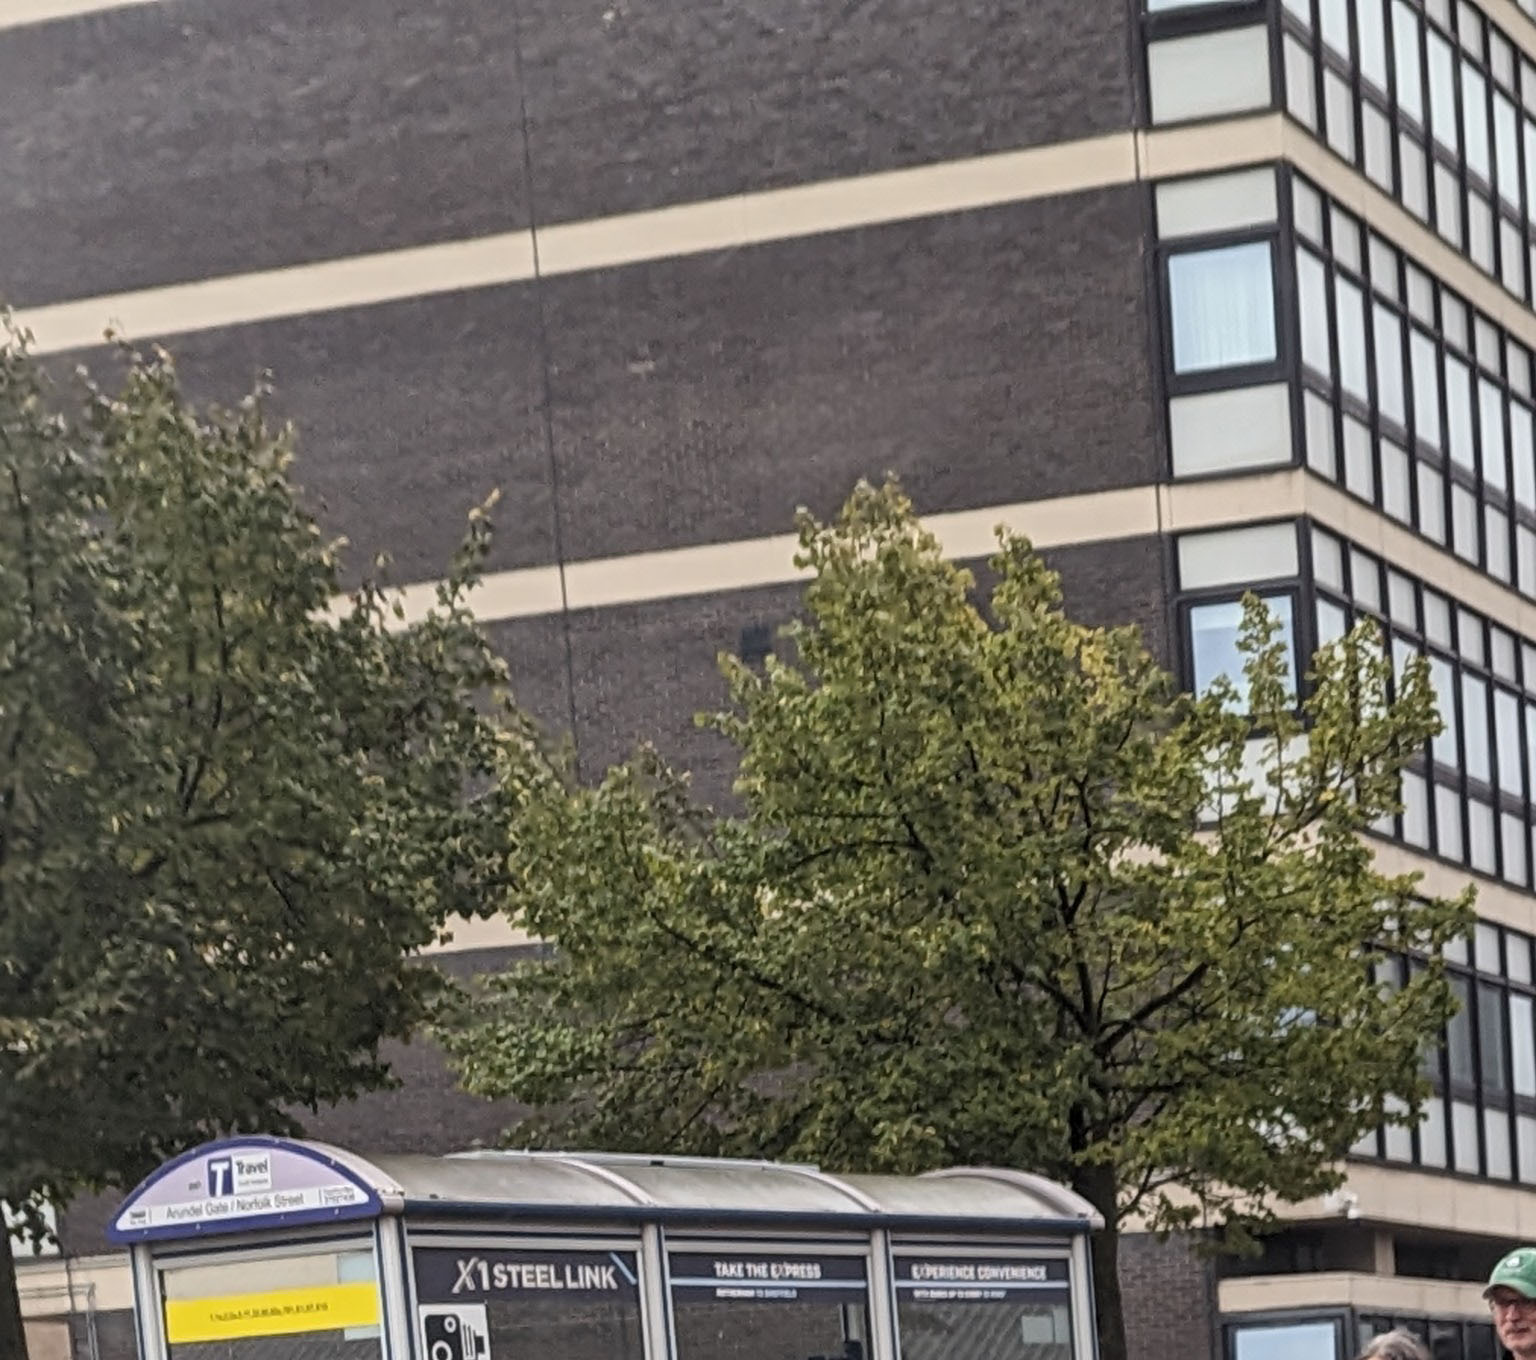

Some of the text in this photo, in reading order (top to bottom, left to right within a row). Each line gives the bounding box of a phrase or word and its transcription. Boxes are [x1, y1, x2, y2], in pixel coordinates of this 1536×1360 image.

[236, 1157, 269, 1175] Travel
[166, 1204, 203, 1219] Arundel
[205, 1201, 229, 1217] Gate
[274, 1193, 304, 1208] Street
[452, 1256, 491, 1294] X1
[714, 1261, 822, 1280] TAKE THE EXPRESS
[911, 1263, 1047, 1281] EXPERIENCE CONVENIENCE
